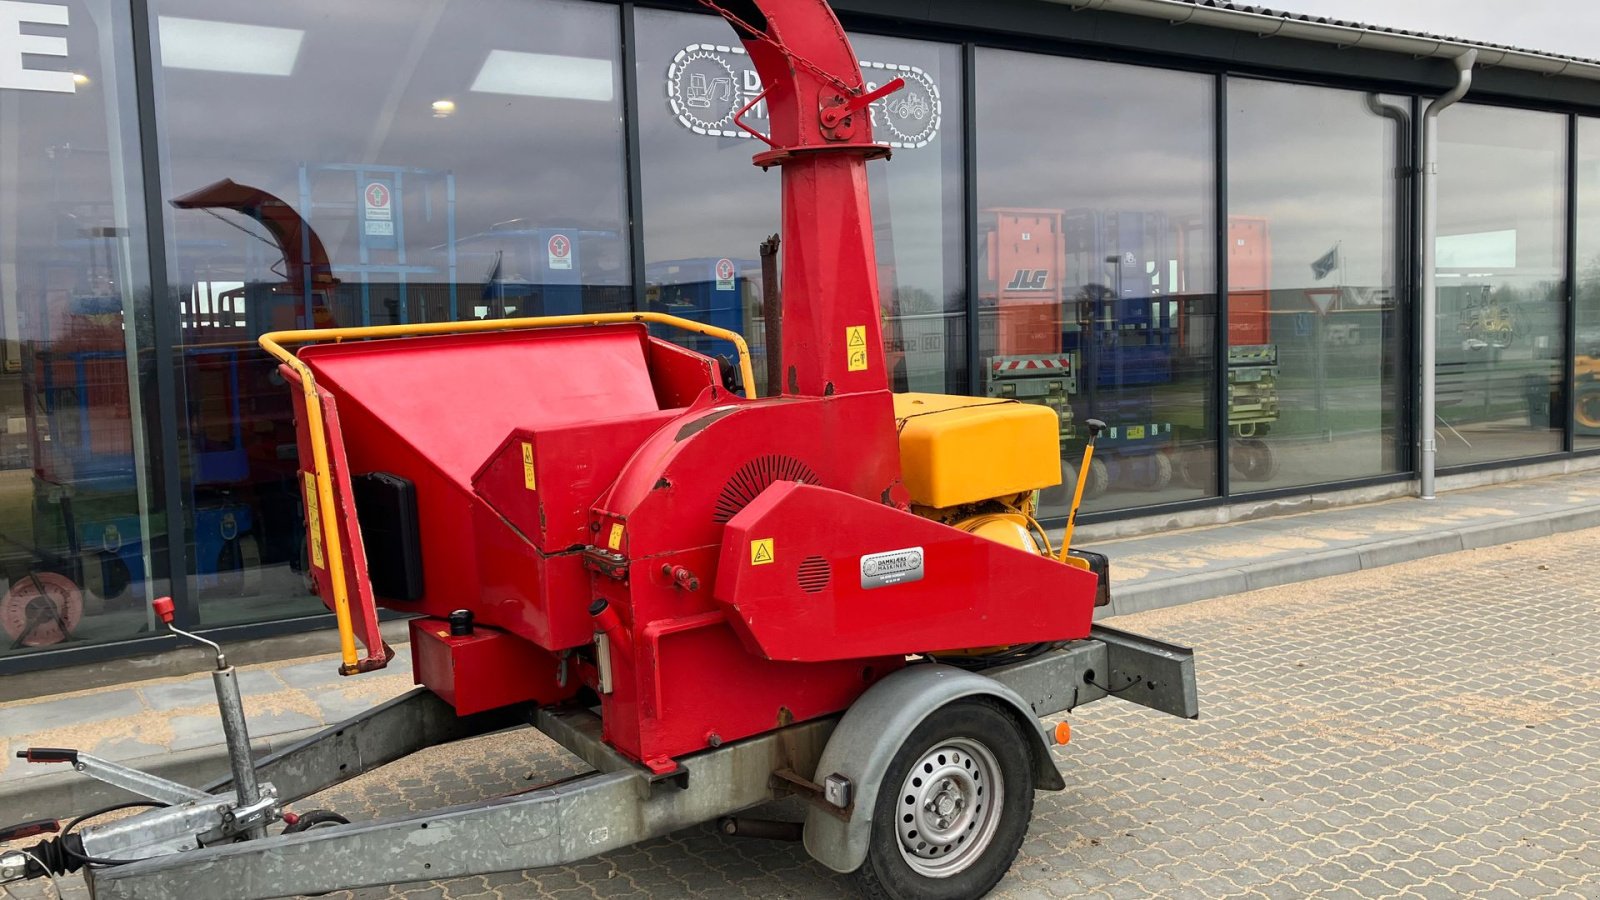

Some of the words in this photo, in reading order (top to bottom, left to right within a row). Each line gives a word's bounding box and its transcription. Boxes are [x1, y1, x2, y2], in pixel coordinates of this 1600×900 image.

[1006, 269, 1049, 290] JLG
[877, 556, 907, 566] DAMKJÆRS
[877, 562, 907, 571] MASKINER
